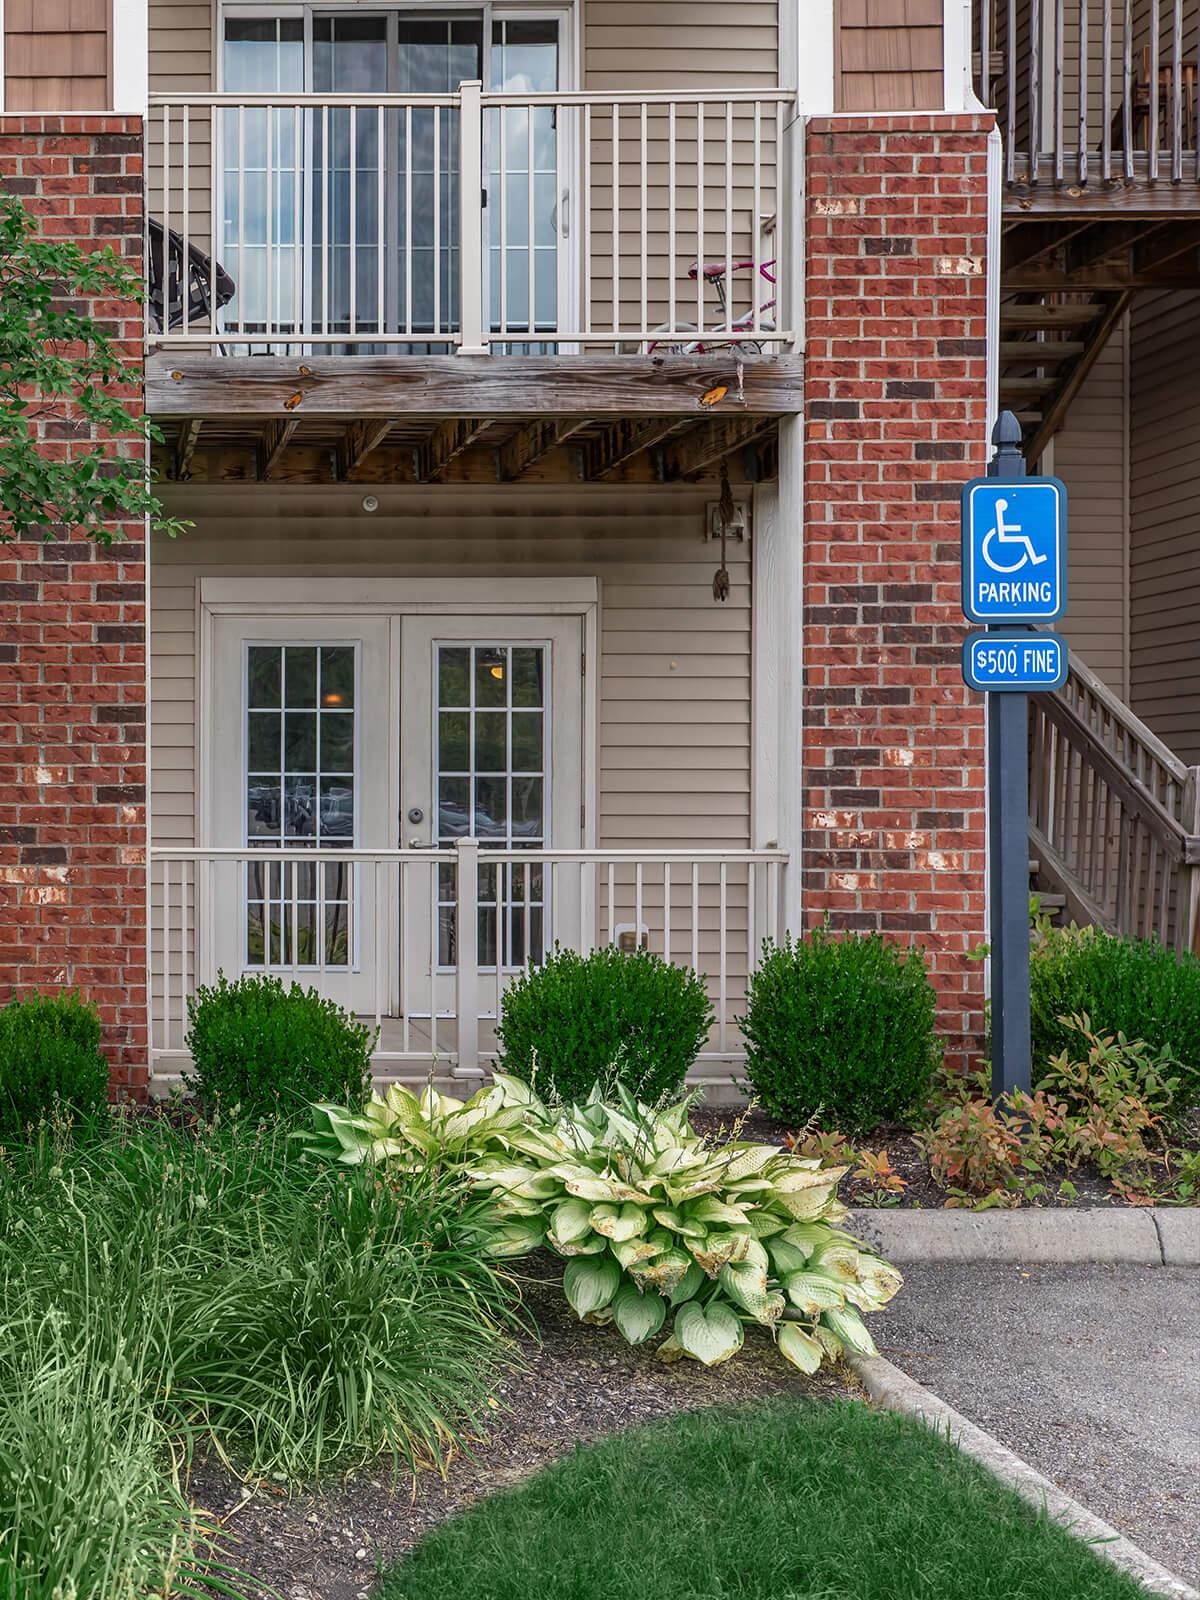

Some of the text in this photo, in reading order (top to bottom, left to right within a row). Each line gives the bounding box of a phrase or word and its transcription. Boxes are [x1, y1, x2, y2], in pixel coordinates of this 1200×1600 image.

[979, 582, 1051, 602] PARKING
[977, 649, 1055, 674] $500 FINE
